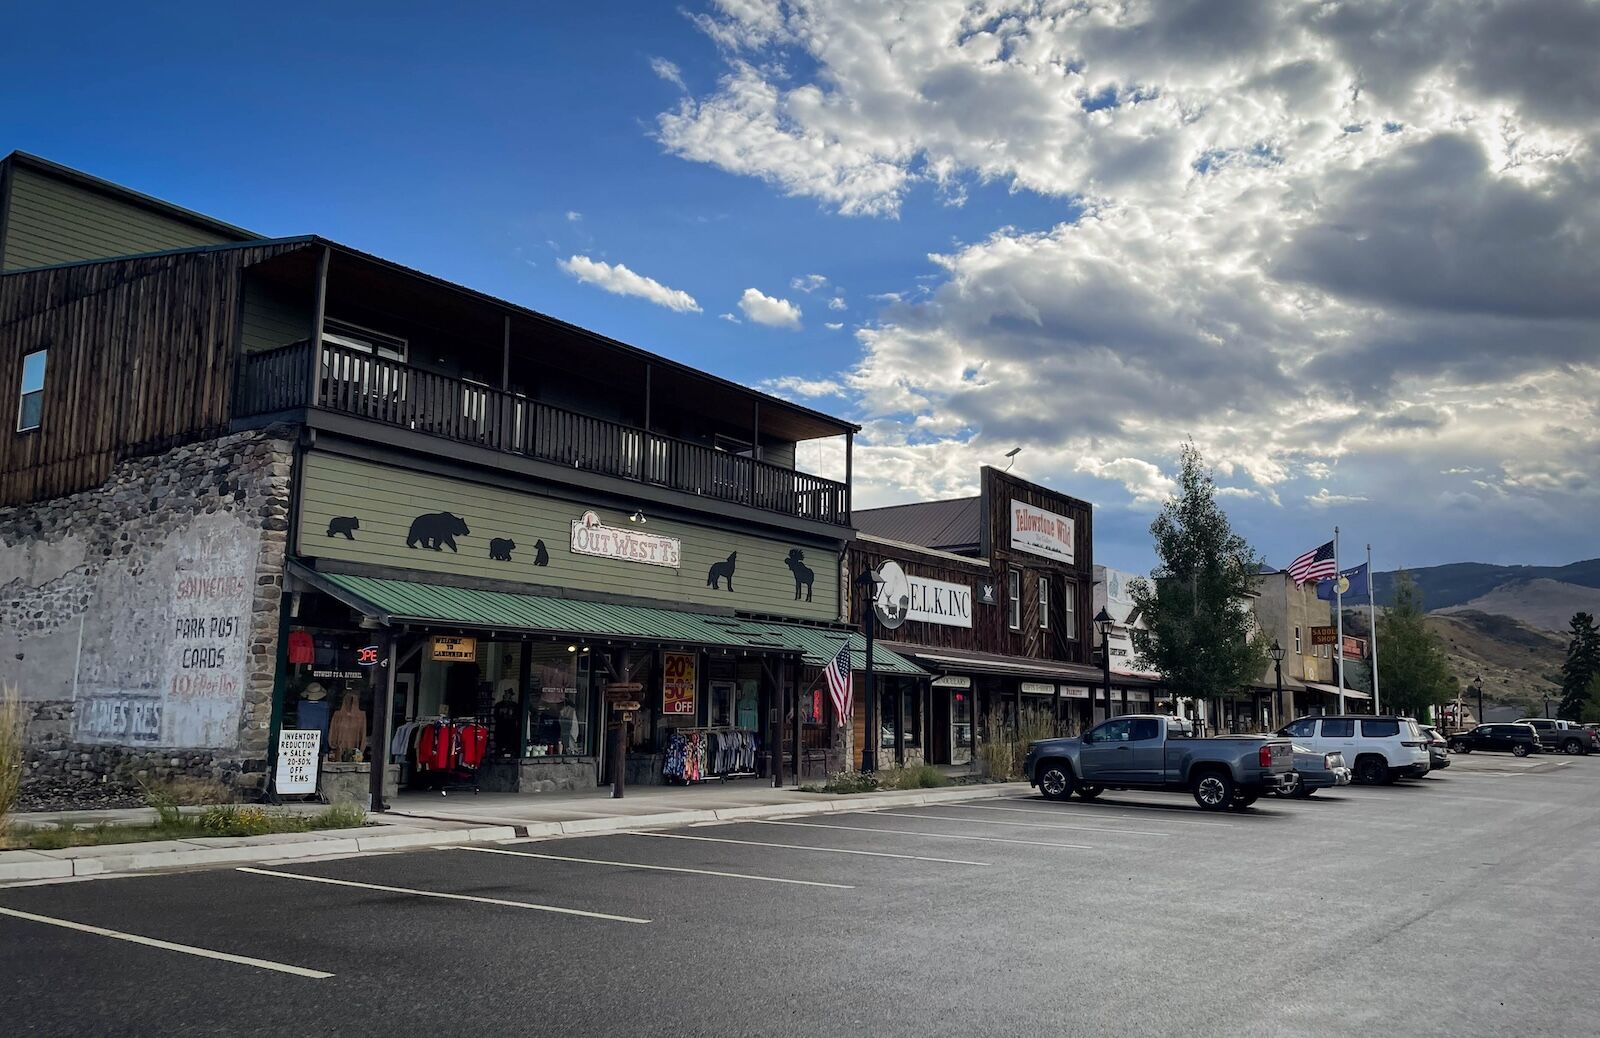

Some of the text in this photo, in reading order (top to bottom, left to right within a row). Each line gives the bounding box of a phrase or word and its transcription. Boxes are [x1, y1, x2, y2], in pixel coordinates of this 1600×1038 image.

[1015, 509, 1071, 548] Yellowstone Wild
[612, 533, 657, 560] WEST
[175, 616, 240, 639] PARK POST
[1317, 635, 1336, 643] SHOP
[182, 648, 225, 669] CARDS
[665, 656, 694, 677] 20%
[675, 701, 693, 712] OFF
[284, 732, 319, 741] INVENTORY
[280, 741, 316, 749] REDUCTION
[290, 749, 306, 757] SALE
[287, 758, 311, 766] 20-50%
[289, 766, 303, 774] OFF
[289, 775, 309, 783] TEMS
